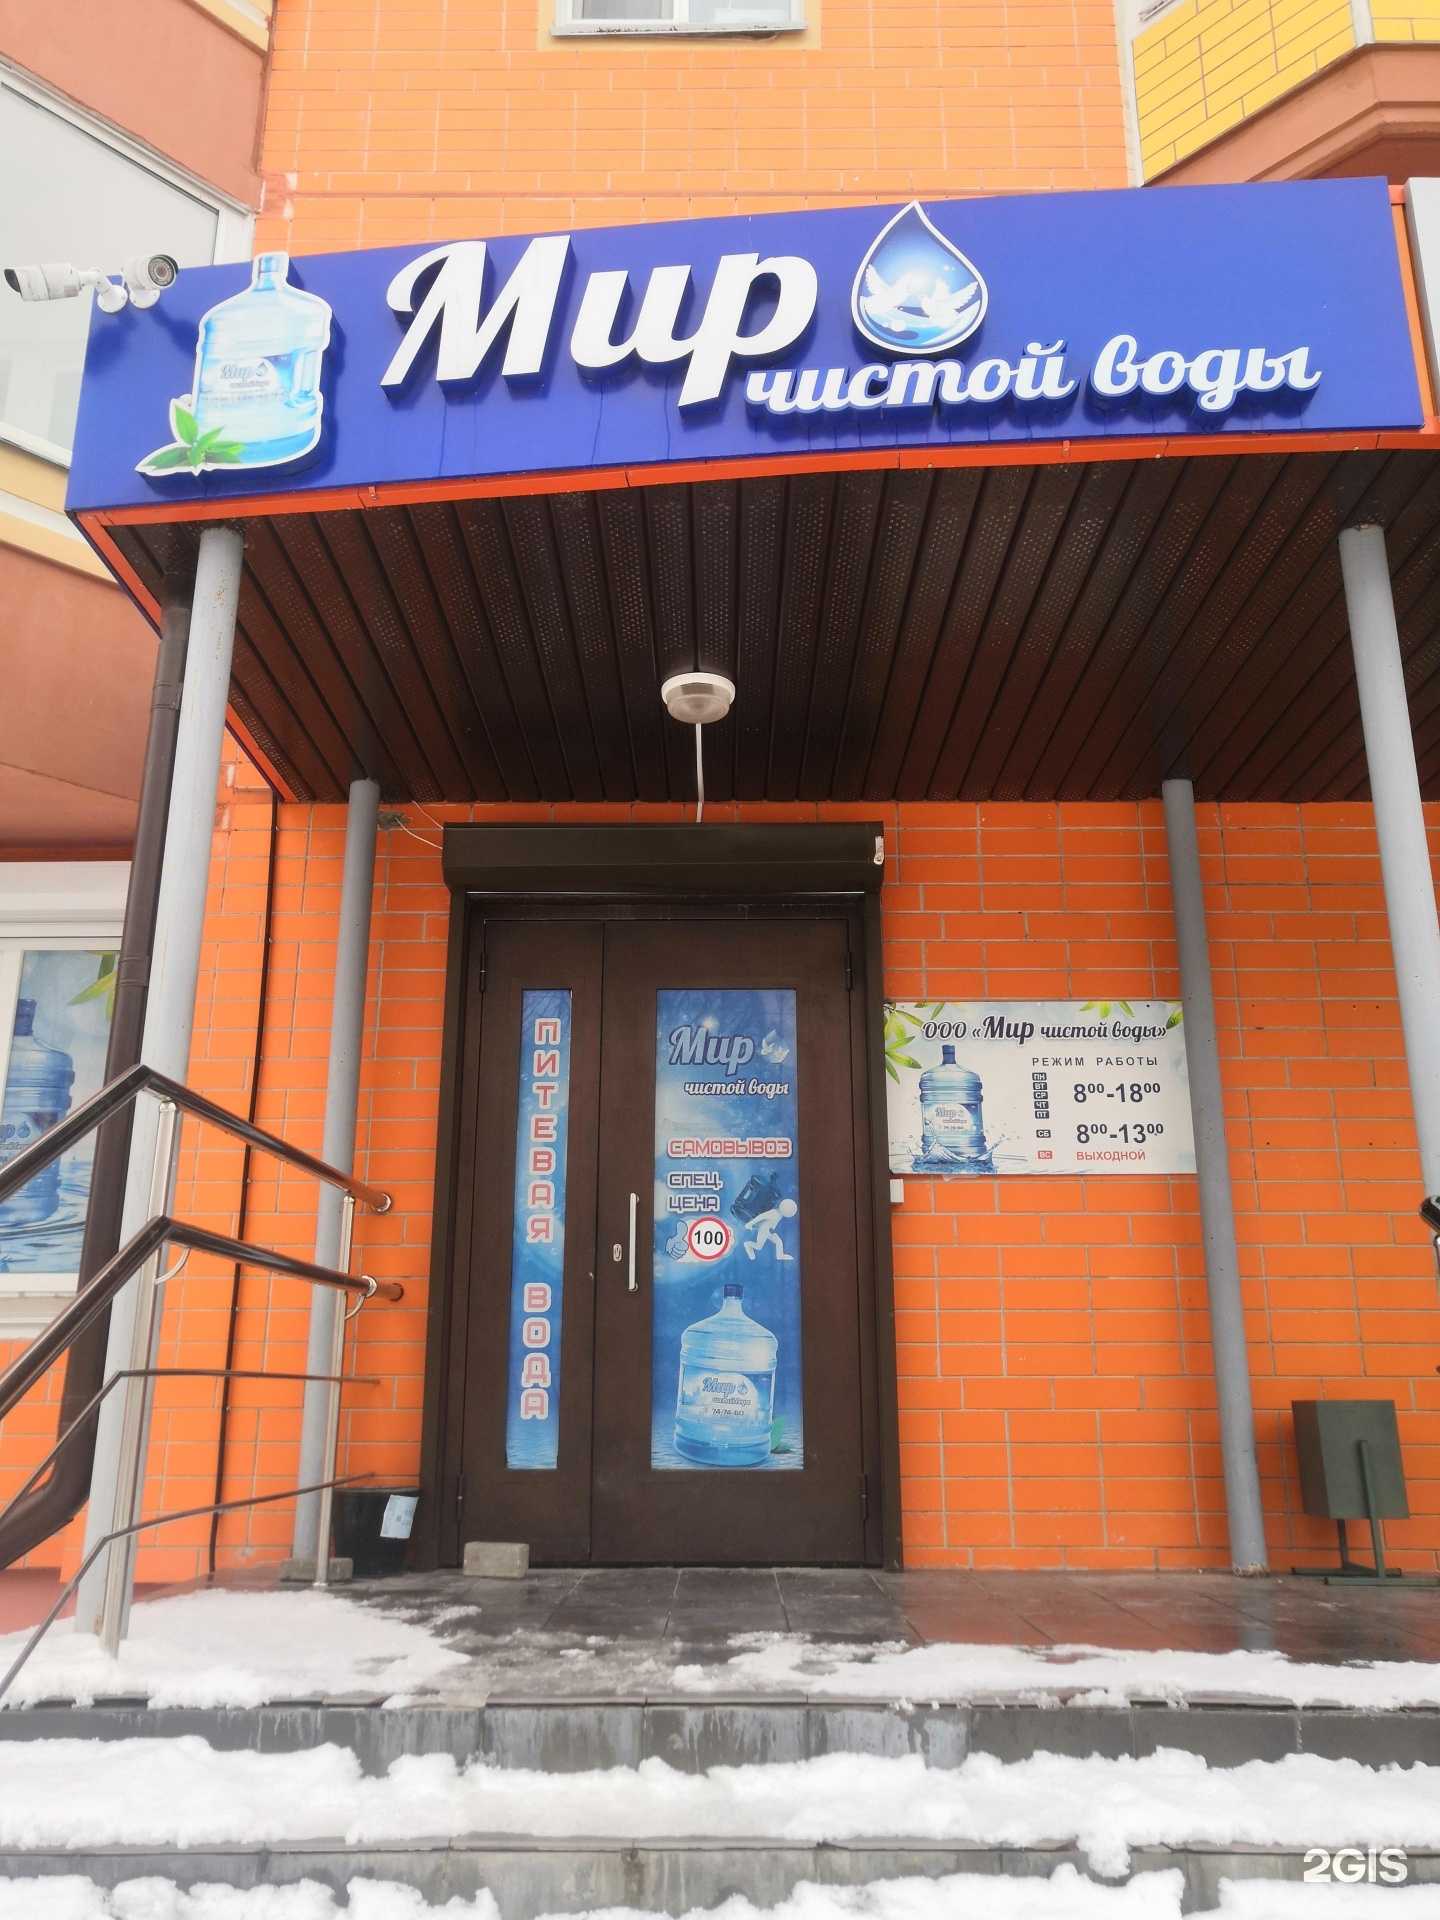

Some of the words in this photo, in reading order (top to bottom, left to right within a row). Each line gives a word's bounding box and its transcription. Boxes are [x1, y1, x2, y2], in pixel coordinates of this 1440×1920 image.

[381, 234, 818, 408] Мир
[746, 340, 1074, 415] чистой
[1092, 333, 1321, 414] воды
[922, 1020, 967, 1039] ООО
[972, 1015, 1034, 1044] «Мир
[1041, 1019, 1110, 1039] чистой
[1112, 1021, 1167, 1043] воды»
[668, 1023, 755, 1076] Мир
[1032, 1057, 1085, 1067] РЕЖИМ
[1096, 1057, 1158, 1067] РАБОТЫ
[684, 1080, 746, 1096] чистой
[747, 1078, 790, 1099] воды
[669, 1139, 791, 1156] САМОВЫВОЗ
[1076, 1150, 1146, 1161] ВЫХОДНОЙ
[669, 1196, 718, 1213] ЦЕНА
[694, 1230, 724, 1246] 100
[522, 1284, 550, 1418] ВОДА
